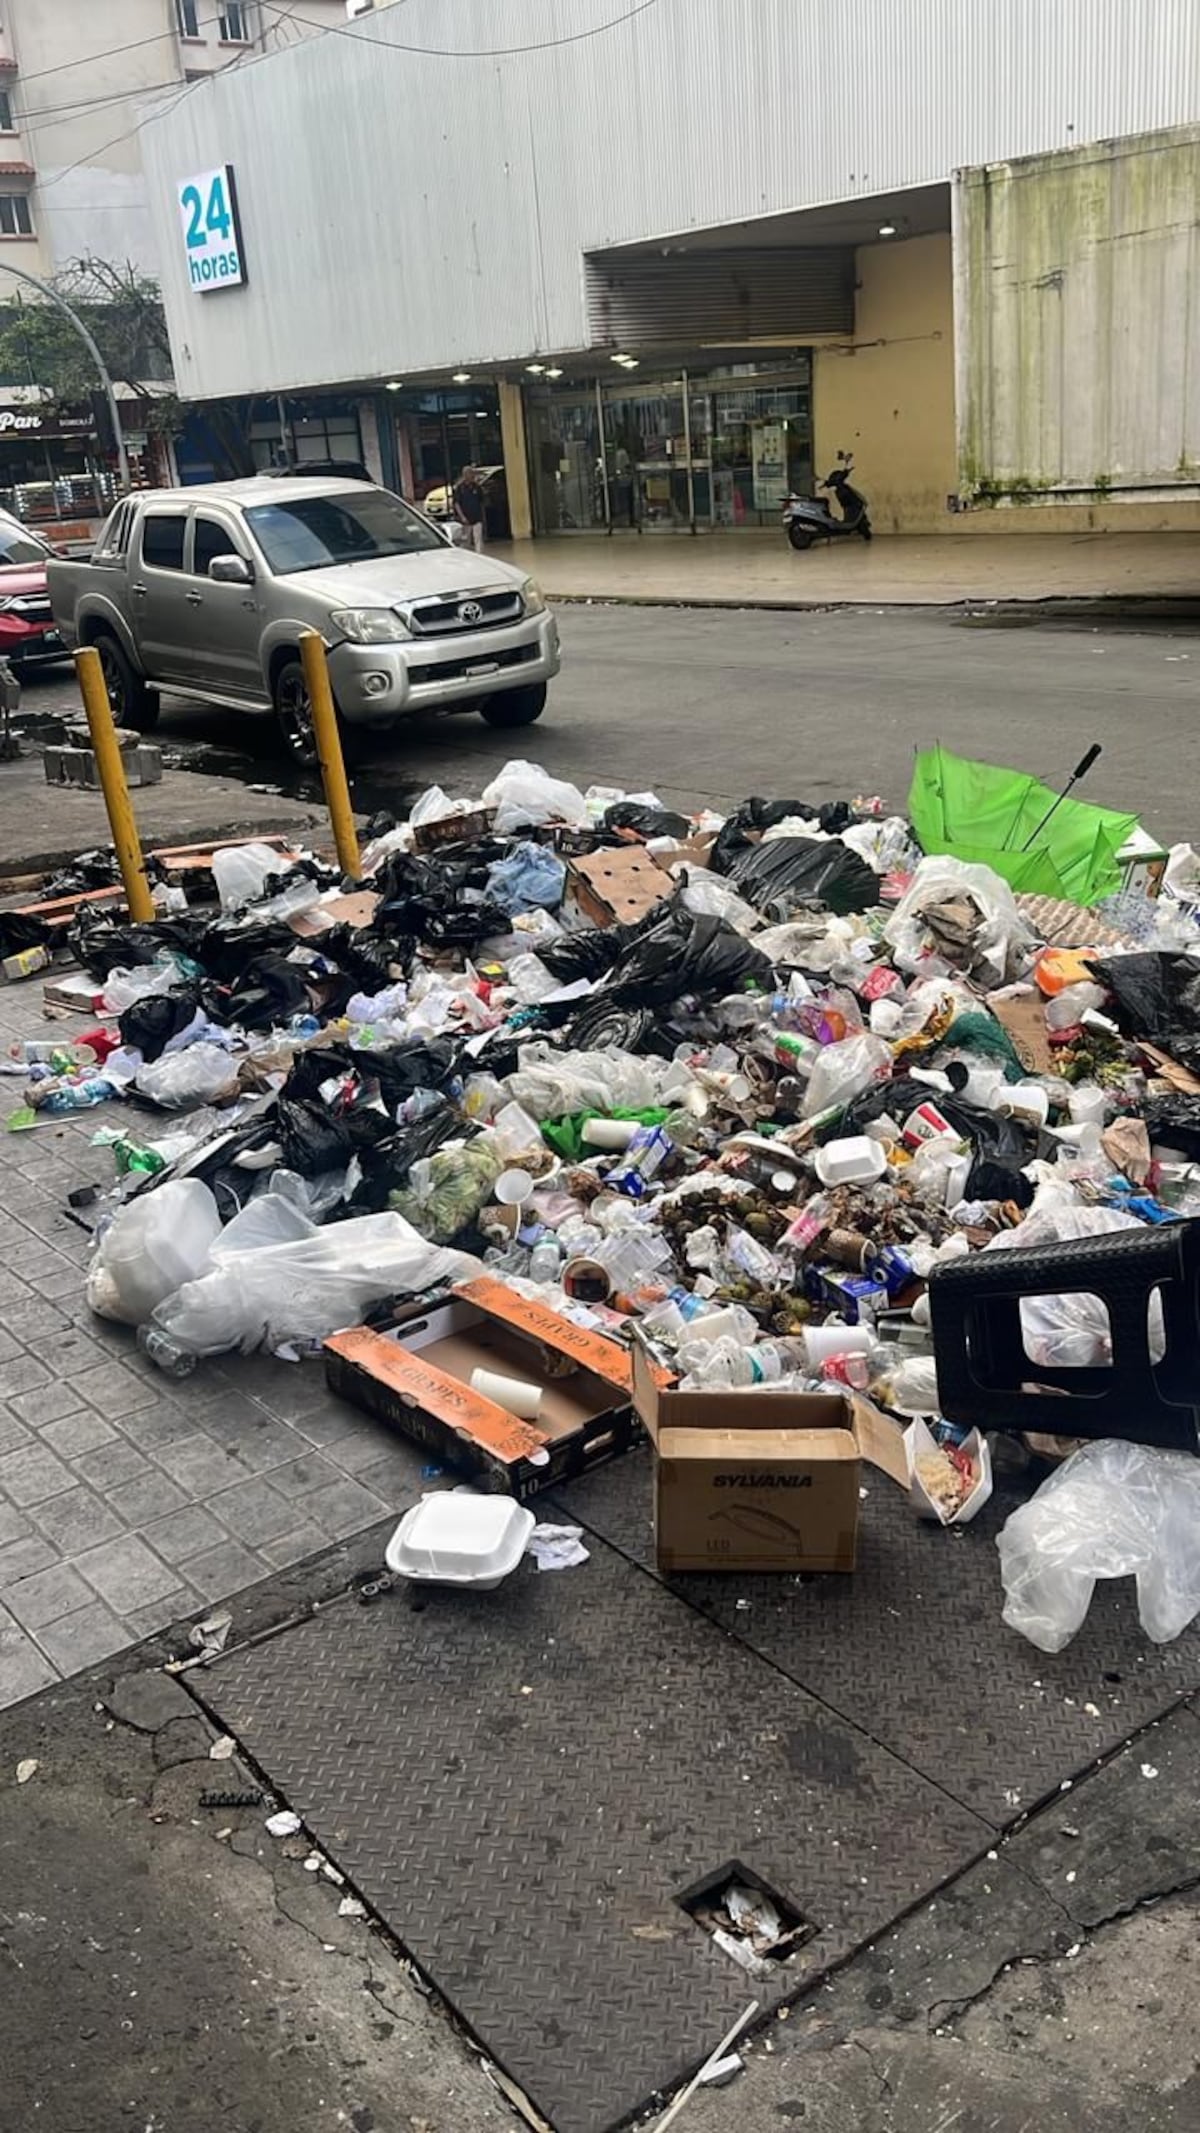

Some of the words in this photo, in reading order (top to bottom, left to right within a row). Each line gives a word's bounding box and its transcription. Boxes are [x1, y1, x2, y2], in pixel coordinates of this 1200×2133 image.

[181, 176, 230, 248] 24
[189, 251, 238, 284] horas
[0, 412, 42, 432] Pan
[402, 1366, 467, 1408] GRAPES
[520, 1479, 539, 1500] 10
[713, 1475, 812, 1488] SYLVANIA
